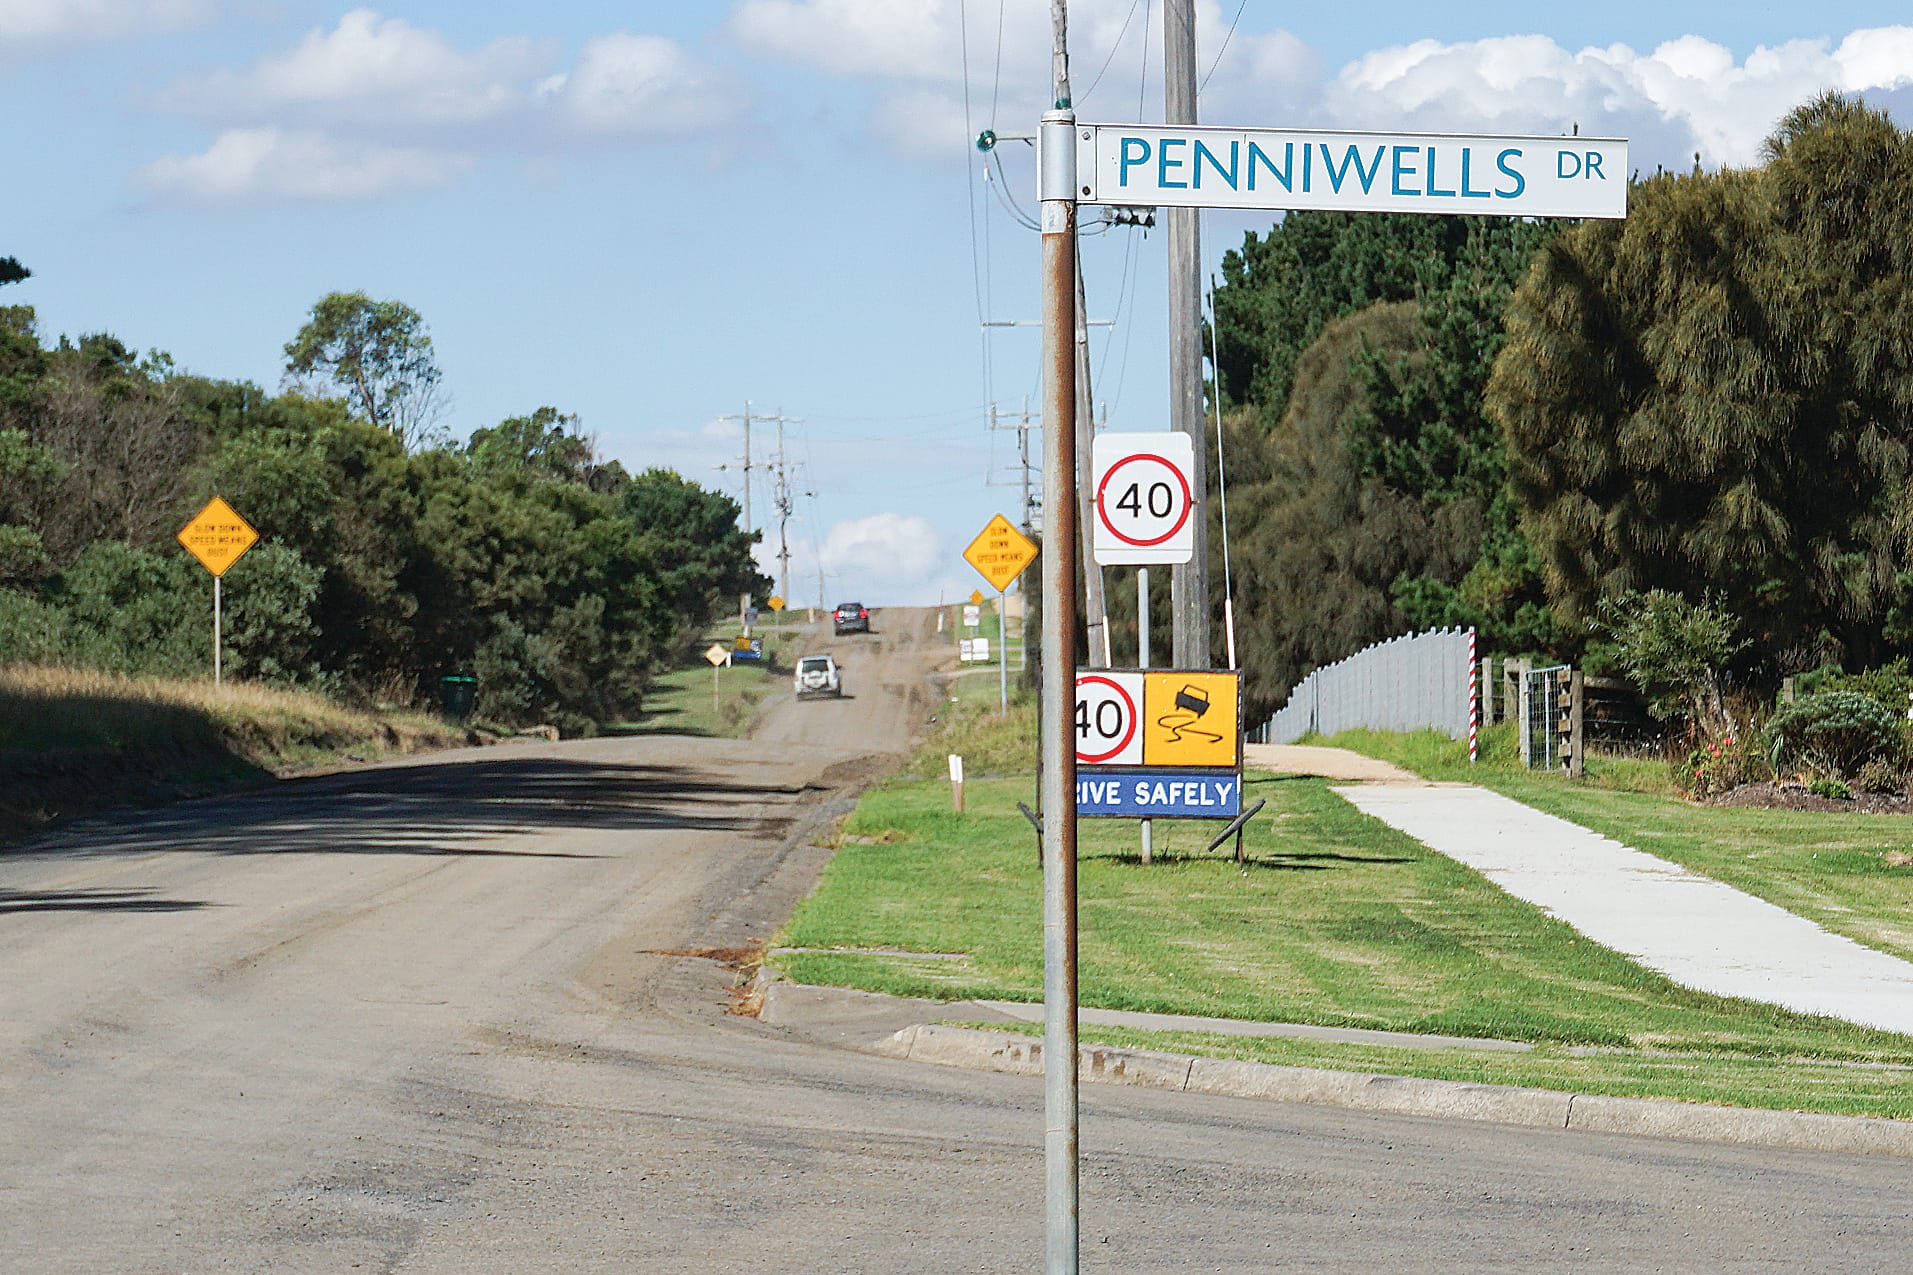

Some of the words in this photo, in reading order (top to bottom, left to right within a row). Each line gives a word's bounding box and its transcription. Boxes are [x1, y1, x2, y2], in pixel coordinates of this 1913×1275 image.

[1119, 137, 1525, 200] PENNIWELLS
[1557, 150, 1607, 180] DR
[1116, 482, 1173, 519] 40
[1076, 781, 1121, 805] IVE
[1134, 781, 1233, 806] SAFELY
